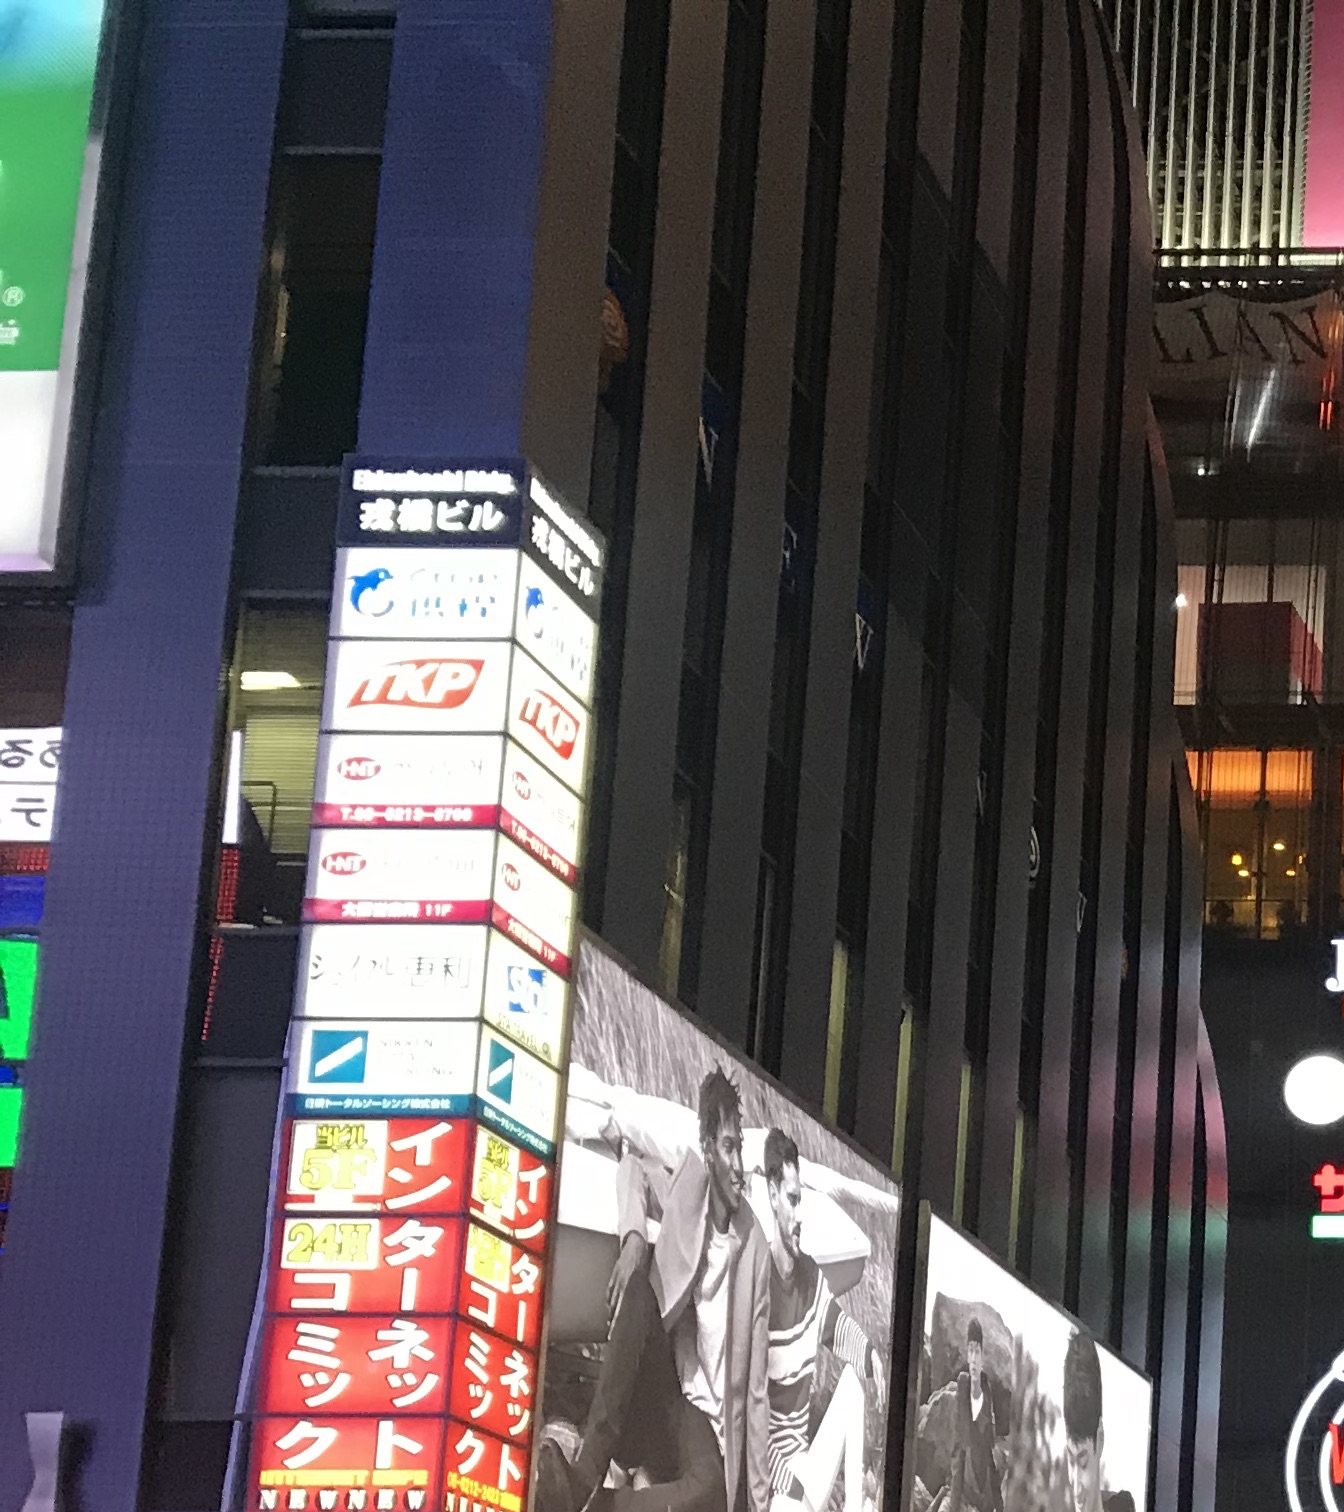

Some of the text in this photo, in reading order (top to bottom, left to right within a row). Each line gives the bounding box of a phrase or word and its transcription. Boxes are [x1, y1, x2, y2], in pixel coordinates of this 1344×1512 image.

[360, 660, 478, 703] TKP
[523, 691, 578, 756] TKP
[299, 1147, 377, 1190] 5F
[284, 1222, 372, 1265] 24H
[367, 1121, 454, 1470] インターネット
[274, 1272, 352, 1470] コミック
[454, 1280, 499, 1476] コミック
[500, 1164, 547, 1491] インターネット
